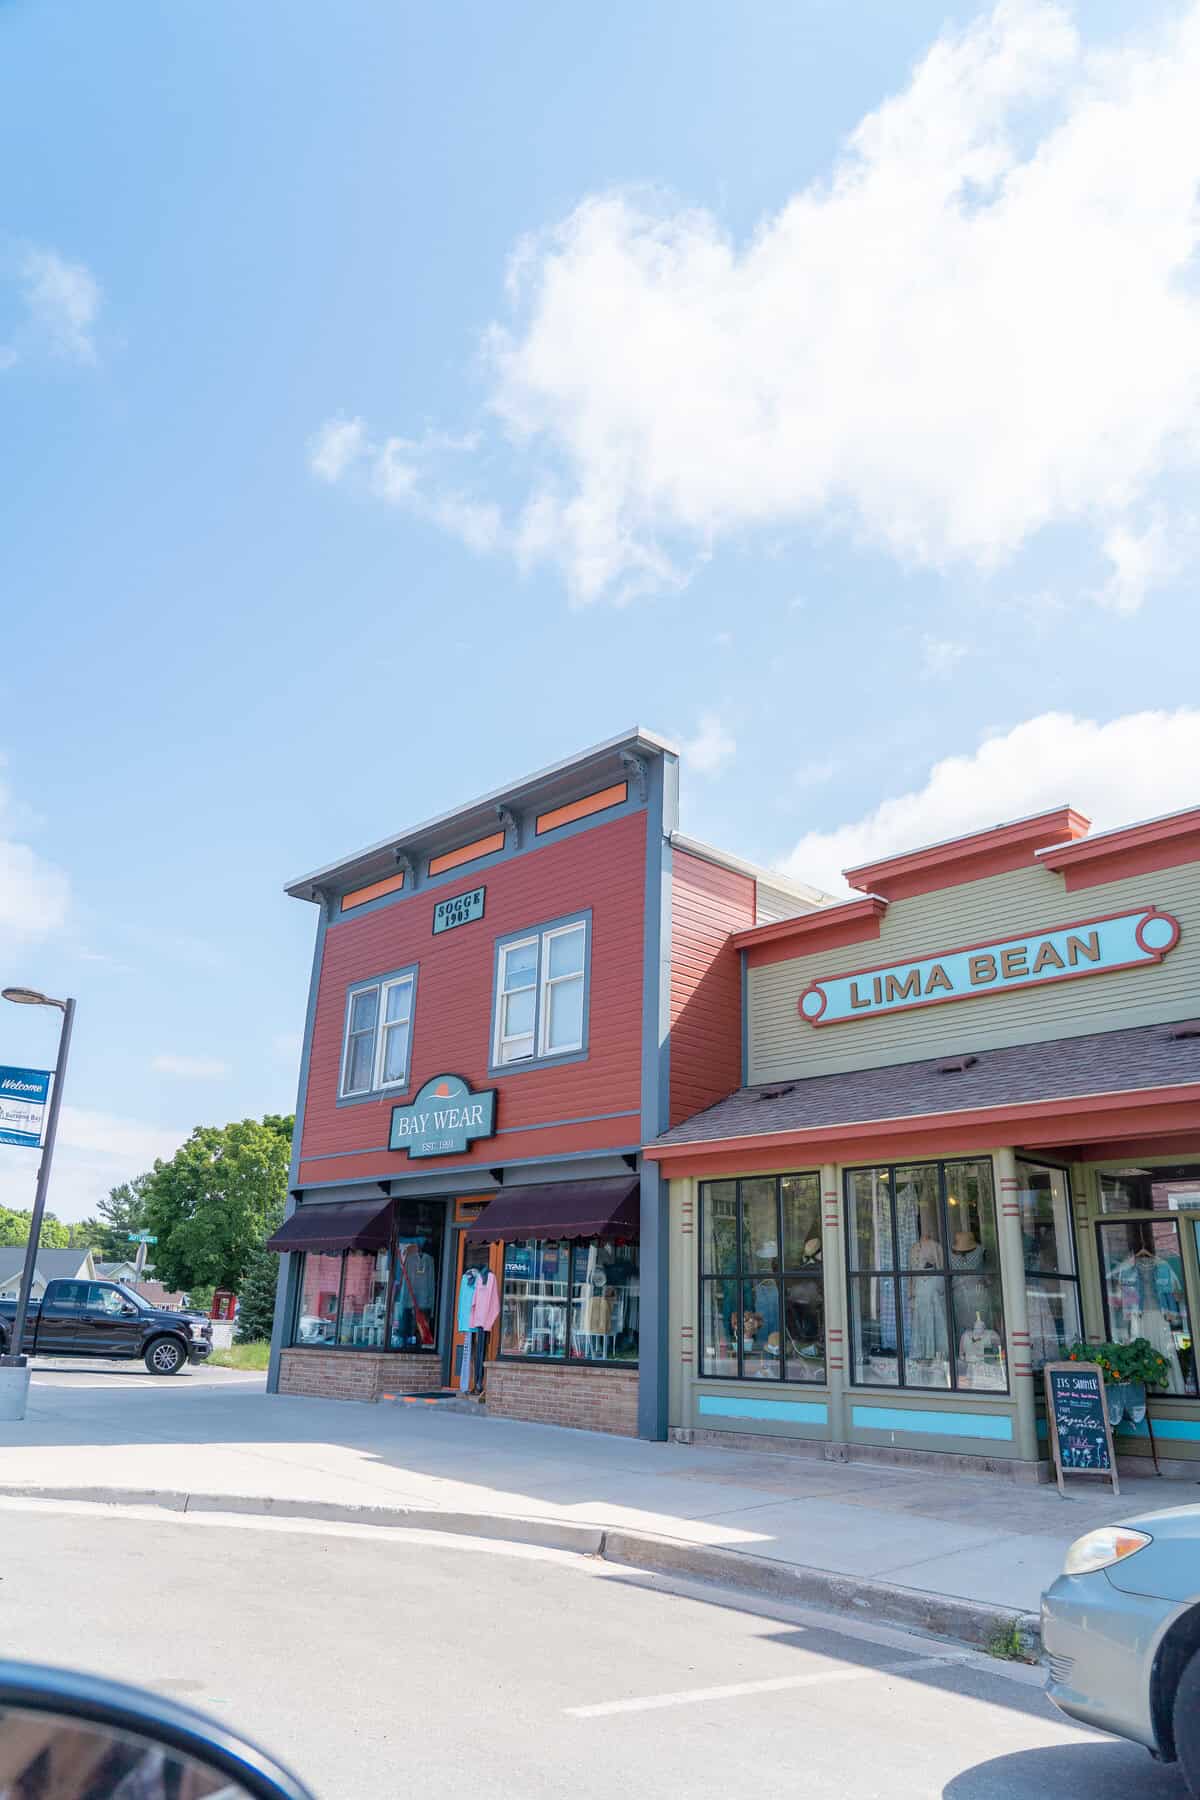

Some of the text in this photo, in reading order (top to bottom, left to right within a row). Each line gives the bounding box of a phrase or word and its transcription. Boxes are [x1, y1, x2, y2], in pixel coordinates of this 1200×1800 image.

[438, 892, 480, 917] SOGGE
[445, 909, 469, 928] 1903
[849, 932, 1100, 1009] LIMA BEAN
[1, 1079, 42, 1092] Welcome
[398, 1105, 483, 1136] BAY WEAR
